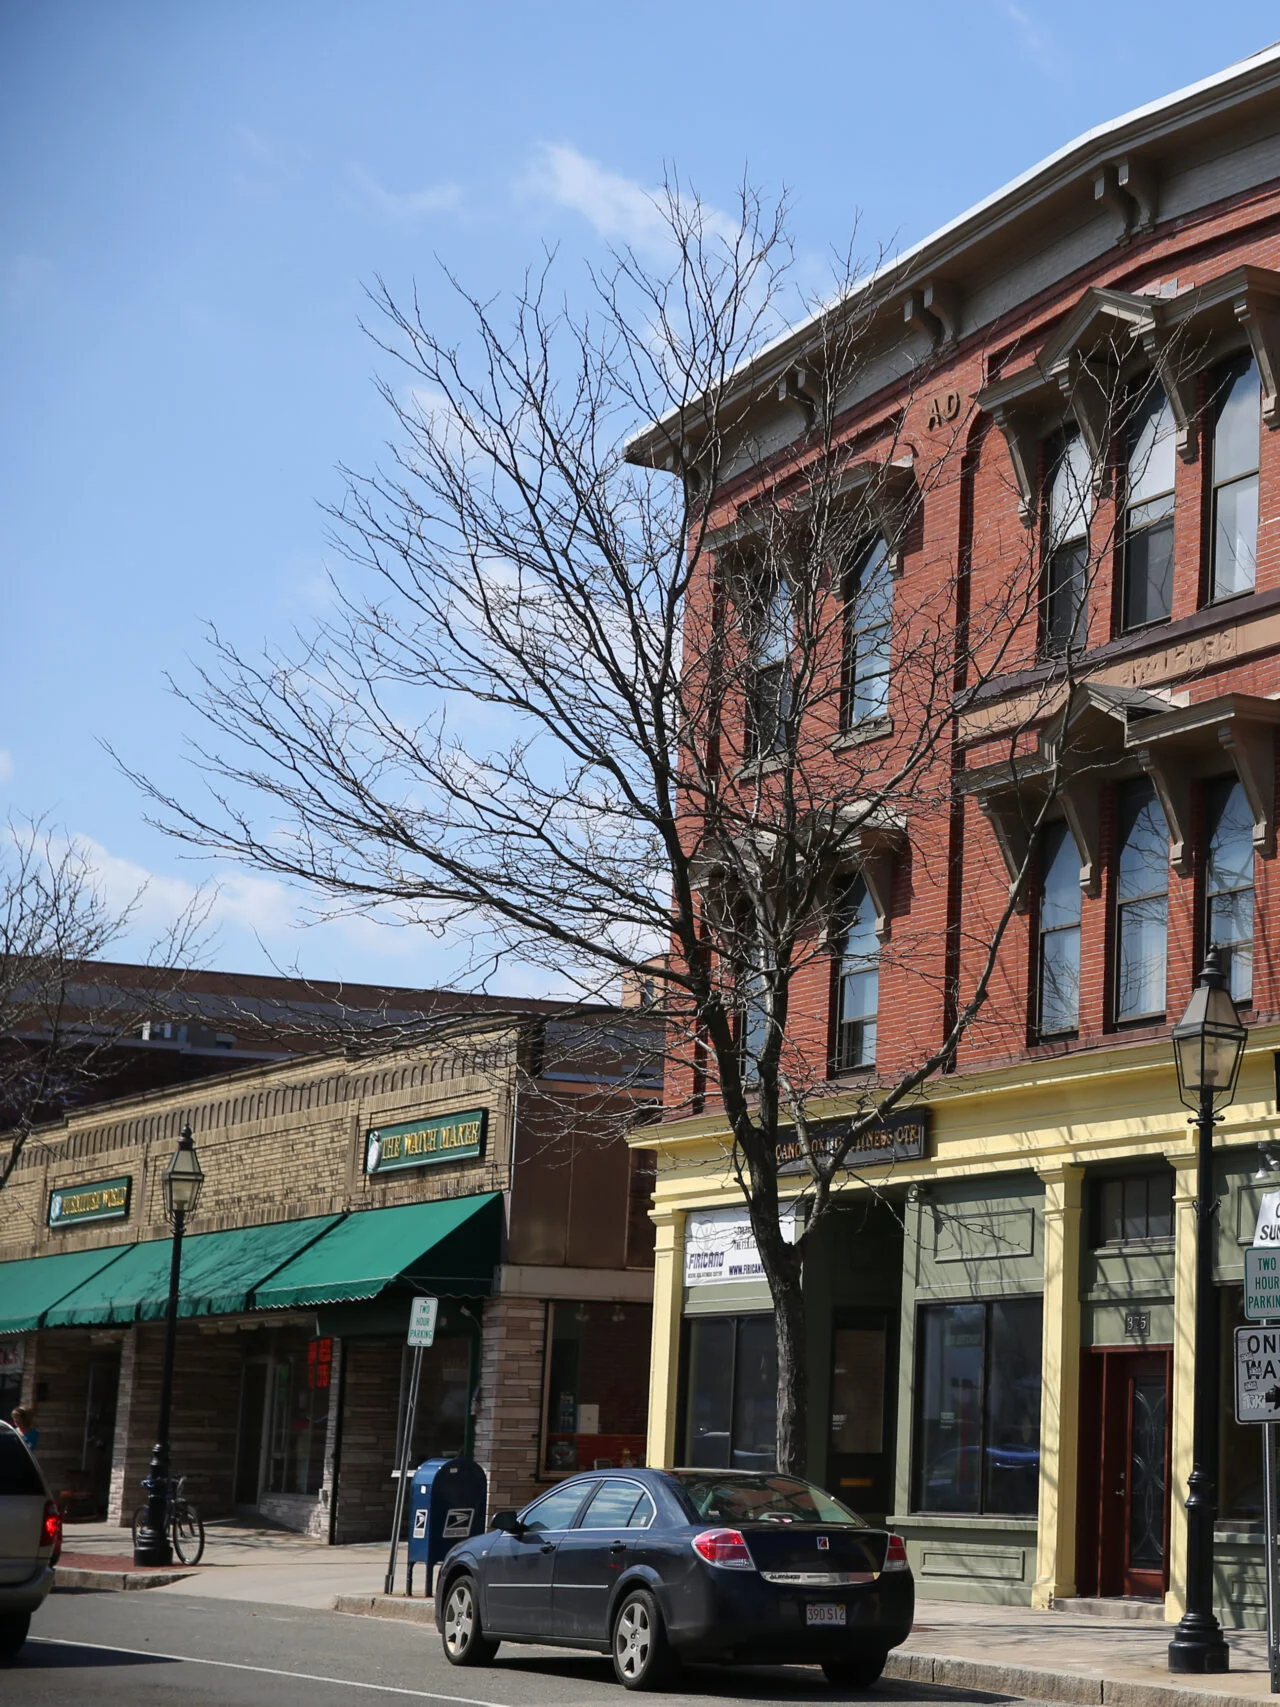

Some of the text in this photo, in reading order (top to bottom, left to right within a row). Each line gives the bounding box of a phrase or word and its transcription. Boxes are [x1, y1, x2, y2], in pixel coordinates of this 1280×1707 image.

[381, 1121, 480, 1160] THE WATCH MAKER
[1258, 1257, 1277, 1271] TWO
[1255, 1277, 1280, 1290] HOUR
